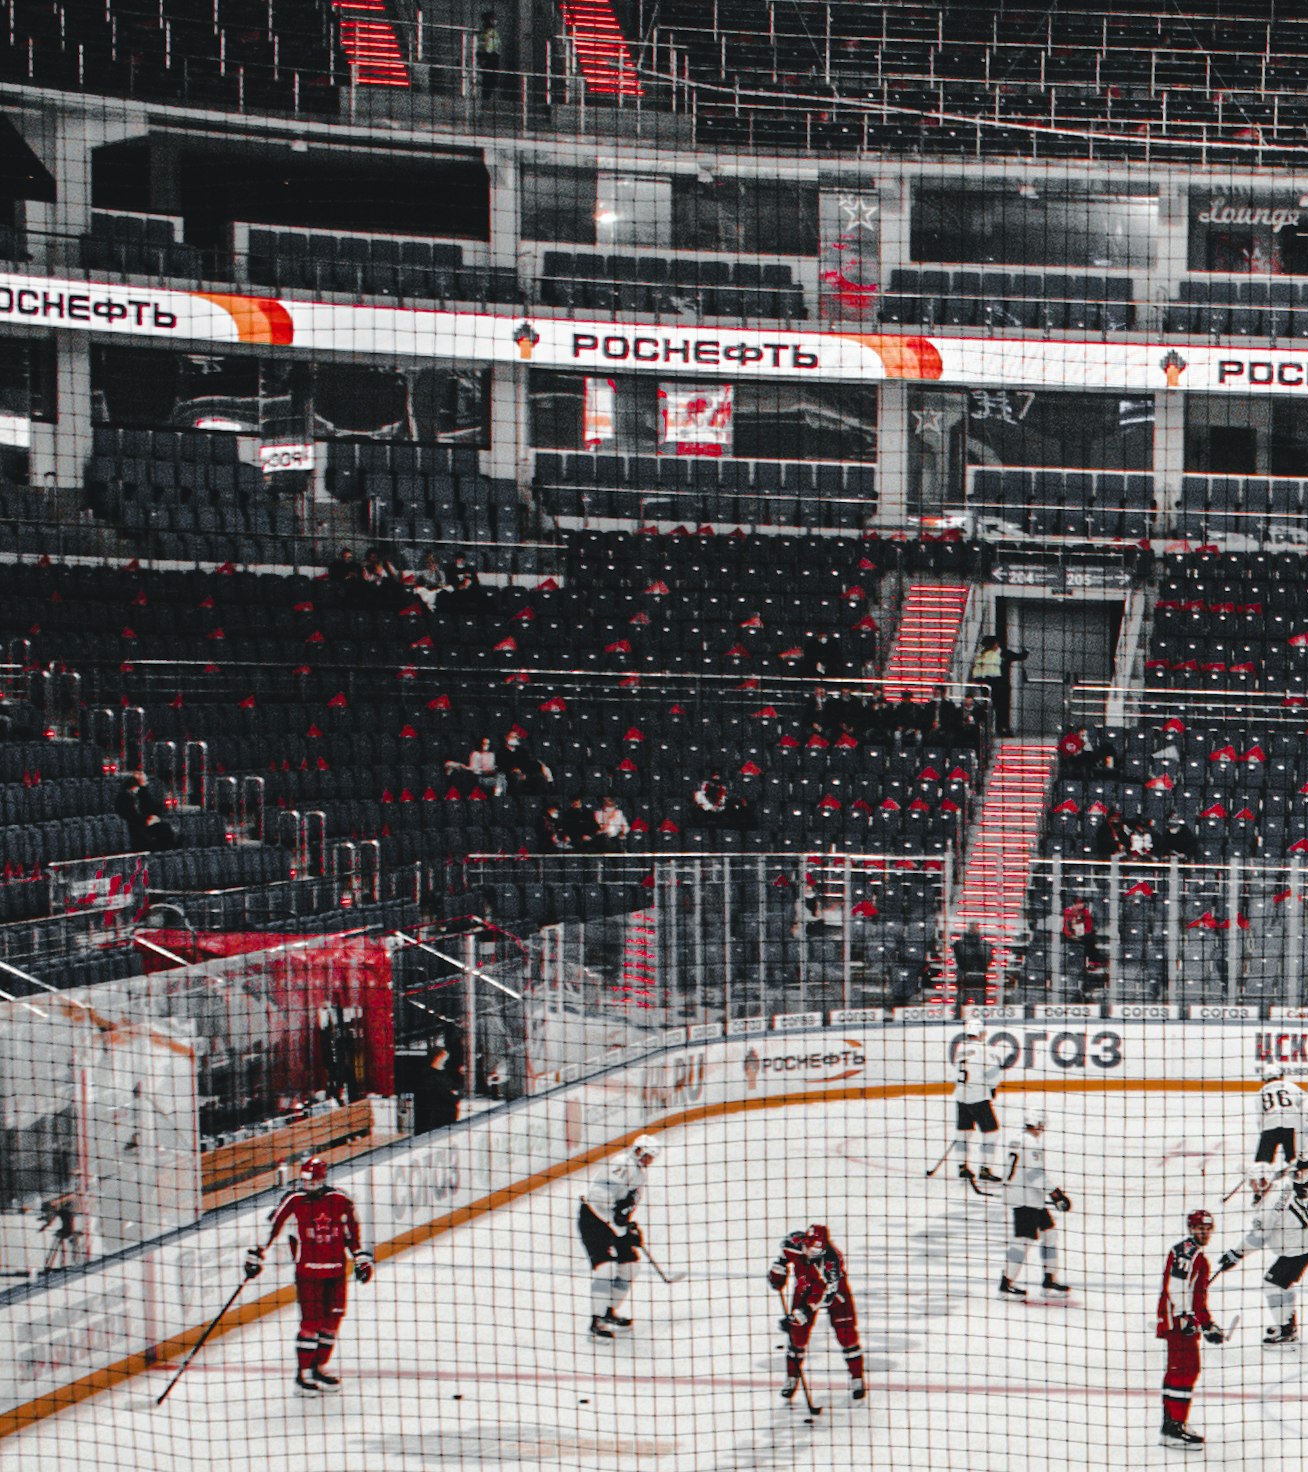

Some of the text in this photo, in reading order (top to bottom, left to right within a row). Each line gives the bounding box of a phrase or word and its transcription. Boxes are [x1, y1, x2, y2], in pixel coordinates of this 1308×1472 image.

[572, 333, 819, 369] РОСНЕФТЬ
[1120, 1005, 1169, 1018] согаз
[1200, 1005, 1249, 1019] согаз
[762, 1050, 865, 1073] РОСНЕФТЬ
